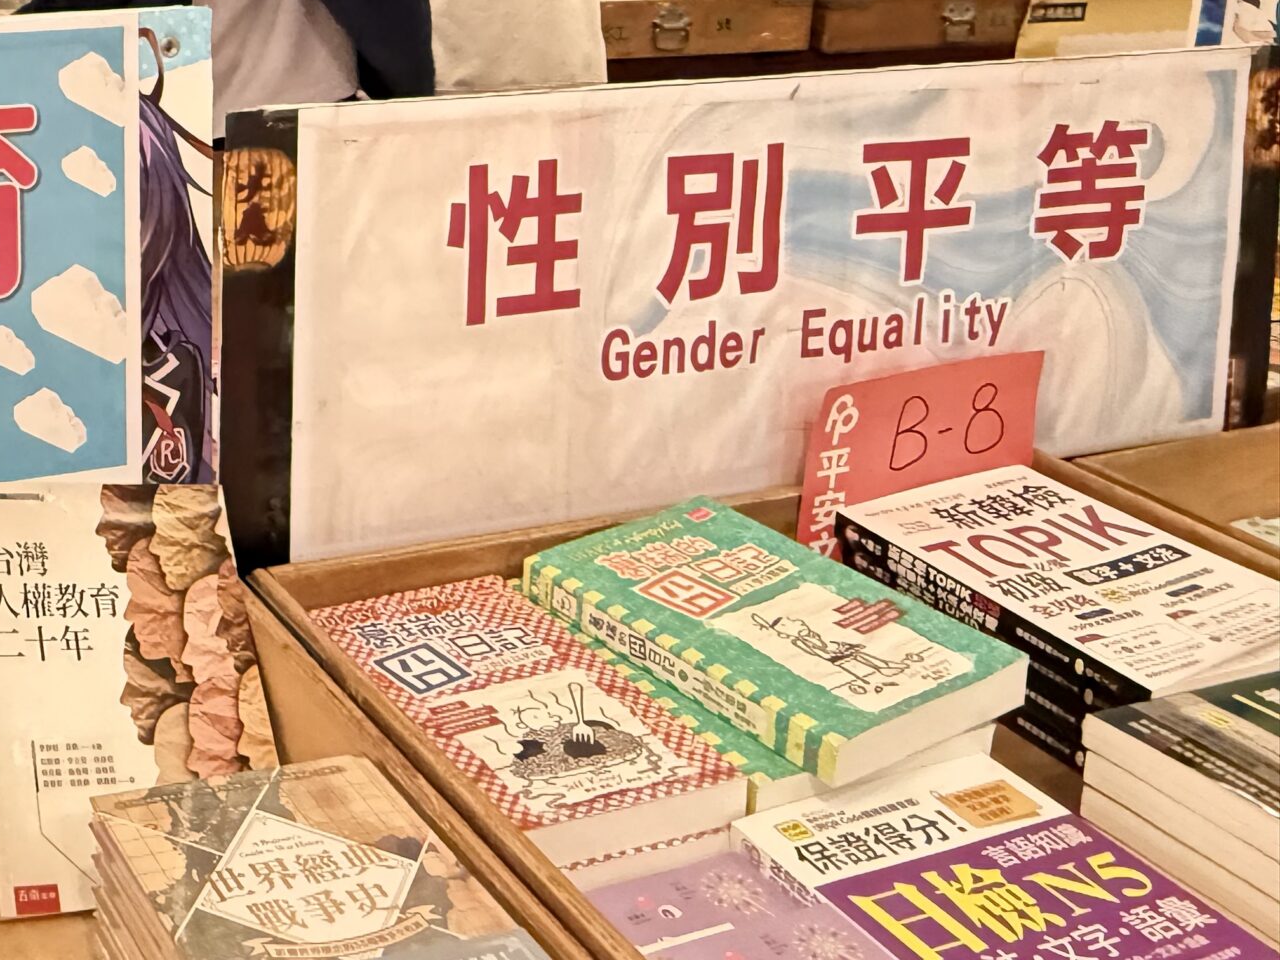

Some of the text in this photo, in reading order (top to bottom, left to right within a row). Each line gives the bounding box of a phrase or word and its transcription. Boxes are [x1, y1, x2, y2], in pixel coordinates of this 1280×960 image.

[446, 119, 1150, 326] 性別平等
[601, 295, 1011, 382] Gender Equality
[888, 382, 1005, 472] B-8
[919, 504, 1156, 579] TOPIK
